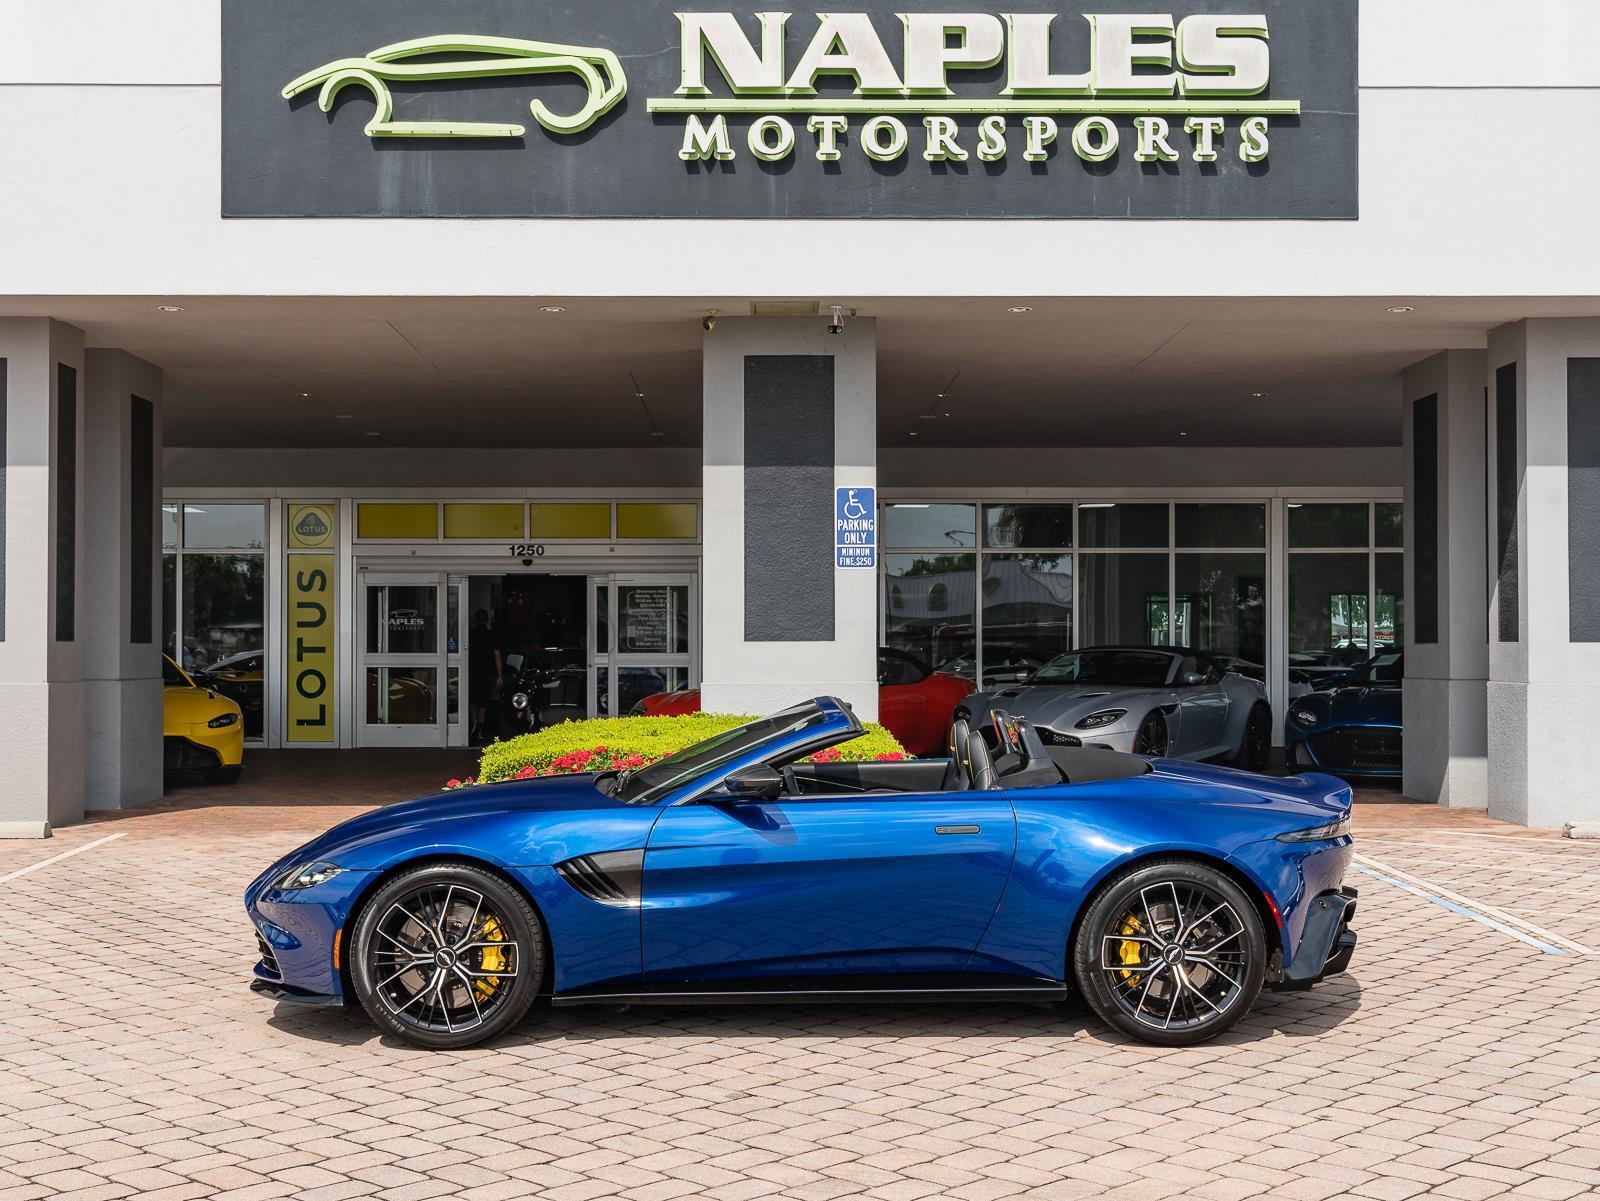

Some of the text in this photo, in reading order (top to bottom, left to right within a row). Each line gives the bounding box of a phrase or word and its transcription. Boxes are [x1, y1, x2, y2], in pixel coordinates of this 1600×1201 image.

[674, 12, 1270, 97] NAPLES
[679, 114, 1269, 162] MOTORSPORTS
[837, 519, 874, 531] PARKING
[844, 532, 867, 544] ONLY
[509, 545, 545, 556] 1250
[841, 547, 870, 556] MINIMUM
[839, 556, 872, 566] FINE $250
[296, 568, 327, 726] LOTUS
